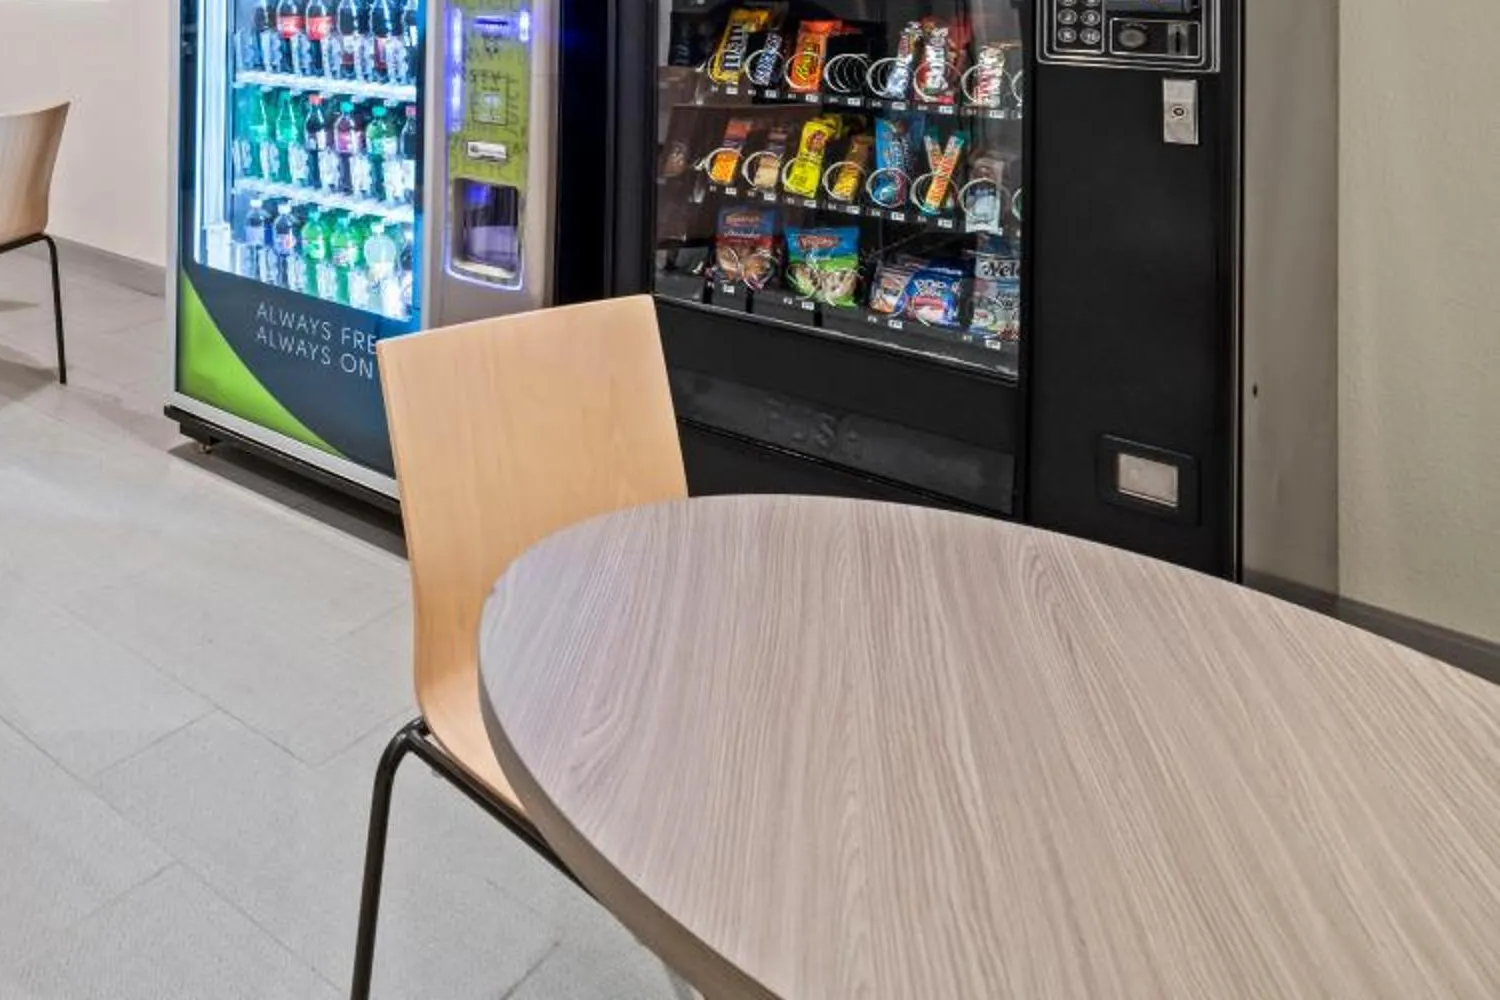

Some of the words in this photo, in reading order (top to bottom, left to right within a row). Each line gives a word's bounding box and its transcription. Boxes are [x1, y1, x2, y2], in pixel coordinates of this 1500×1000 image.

[256, 303, 333, 340] ALWAYS
[256, 326, 332, 366] ALWAYS
[340, 353, 374, 379] ON
